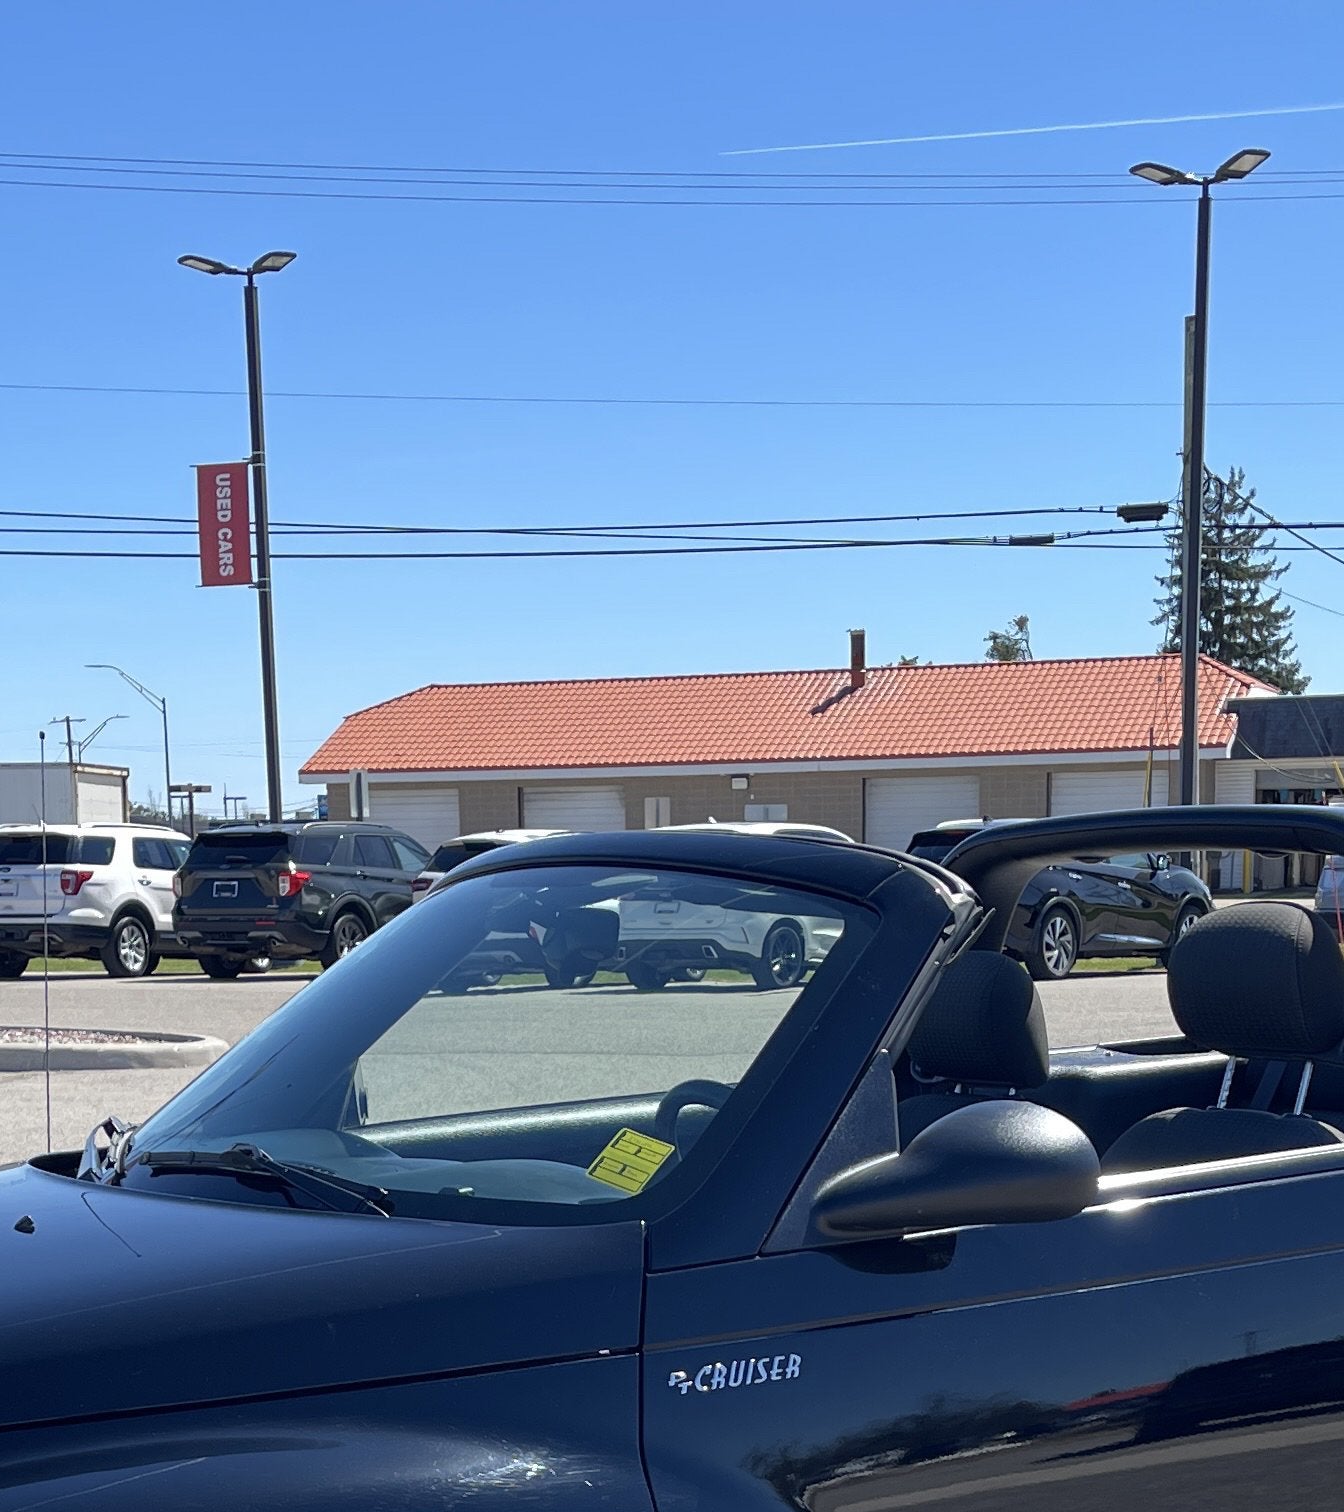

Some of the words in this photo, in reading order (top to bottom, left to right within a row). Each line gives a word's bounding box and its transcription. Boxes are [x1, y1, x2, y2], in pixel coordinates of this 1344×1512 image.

[215, 472, 233, 523] USED
[217, 527, 235, 577] CARS
[668, 1370, 693, 1395] PT
[694, 1353, 803, 1392] CRUISER
